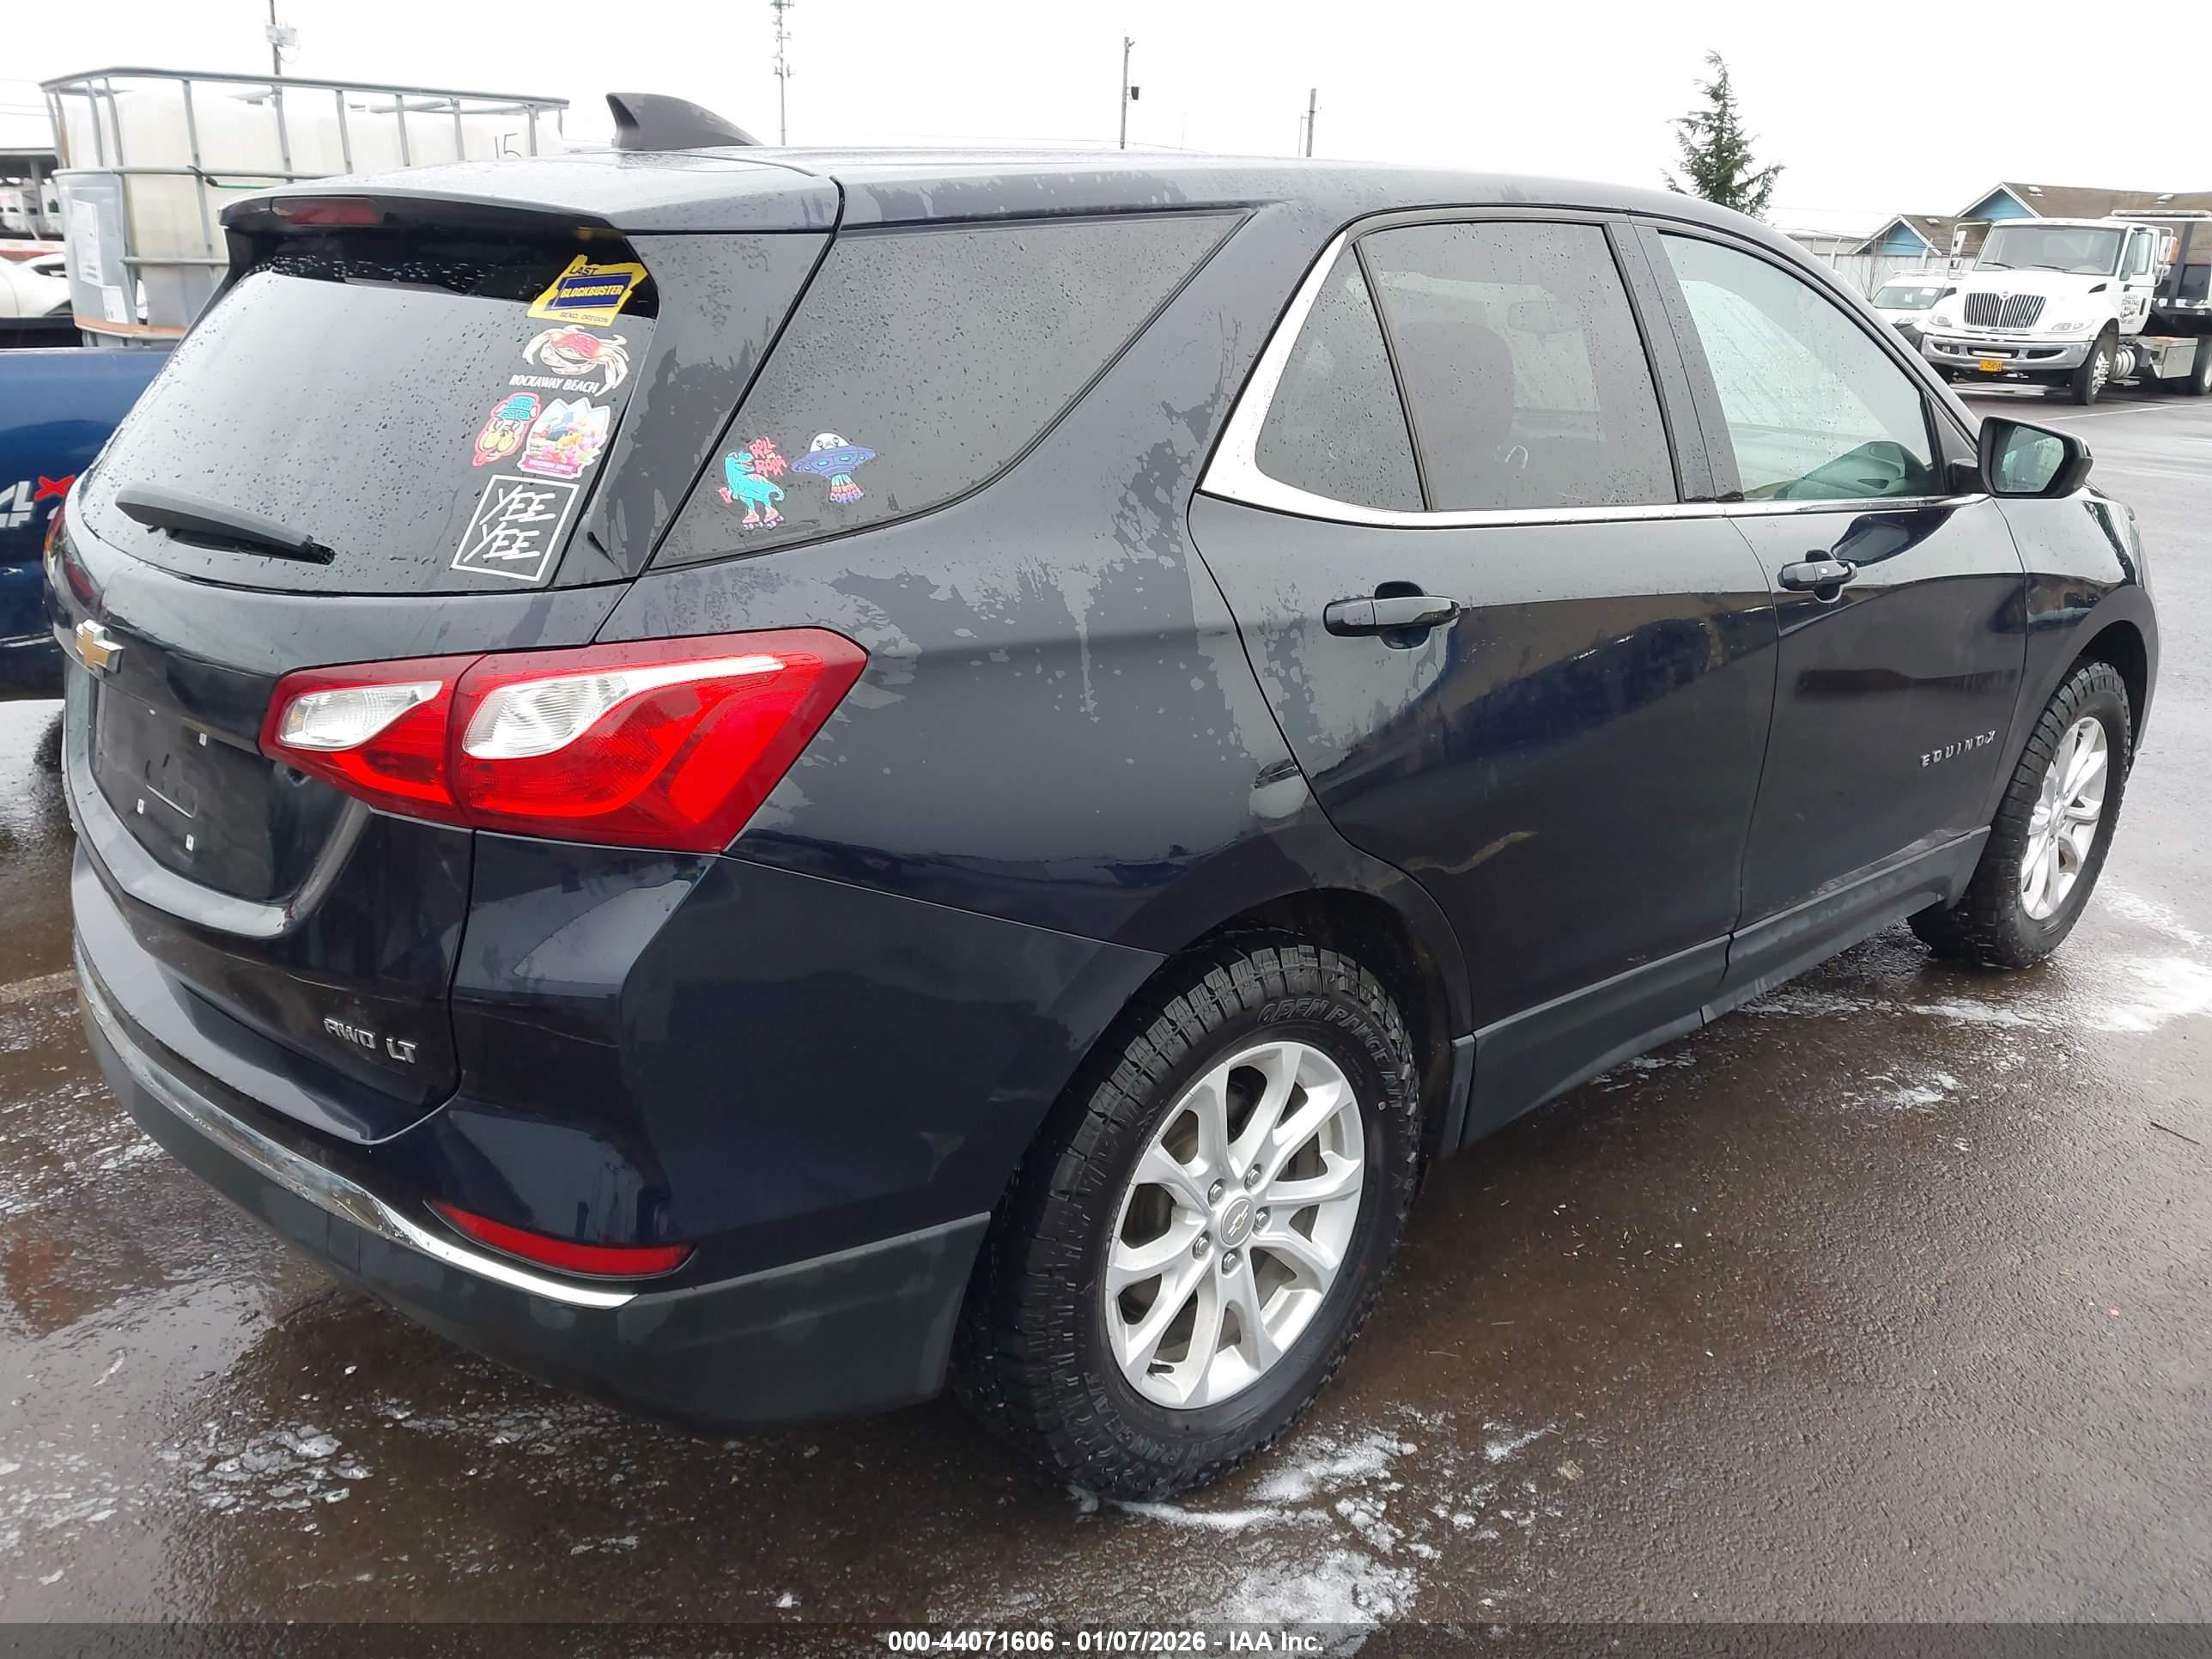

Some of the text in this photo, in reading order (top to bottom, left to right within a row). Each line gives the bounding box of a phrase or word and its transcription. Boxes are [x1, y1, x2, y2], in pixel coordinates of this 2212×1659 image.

[568, 265, 599, 276] LAST
[560, 284, 624, 299] BLOCKBUSTER
[508, 374, 600, 394] ROCKAWAY BEACH
[748, 436, 776, 459] ROLL
[478, 484, 556, 523] YEE
[462, 521, 541, 563] YEE
[1920, 729, 1996, 768] EQUINOX
[323, 1017, 418, 1064] AWD LT
[1257, 997, 1330, 1024] OPEN
[1323, 1003, 1392, 1066] RANGE
